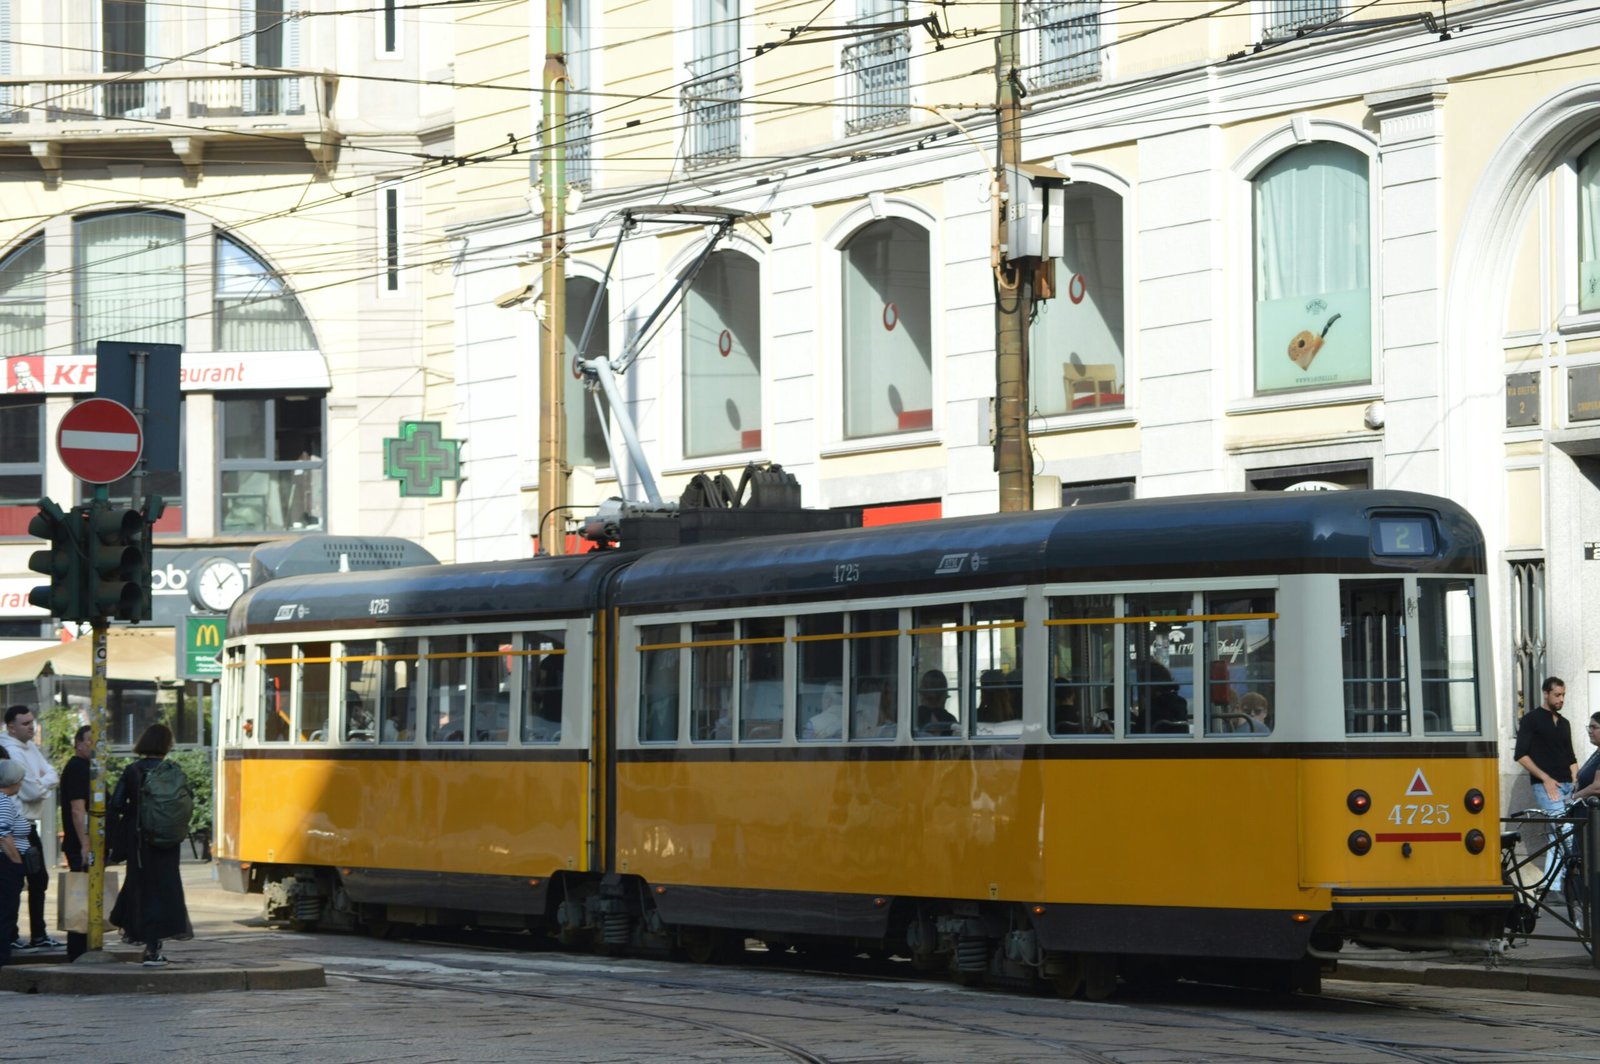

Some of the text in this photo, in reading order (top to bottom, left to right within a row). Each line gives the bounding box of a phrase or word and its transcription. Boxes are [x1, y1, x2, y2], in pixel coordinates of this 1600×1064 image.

[53, 362, 244, 385] KF aurant
[1519, 401, 1525, 414] 2
[1395, 526, 1410, 549] 2
[833, 564, 859, 582] 4725
[368, 599, 390, 615] 4725
[1388, 804, 1450, 825] 4725
